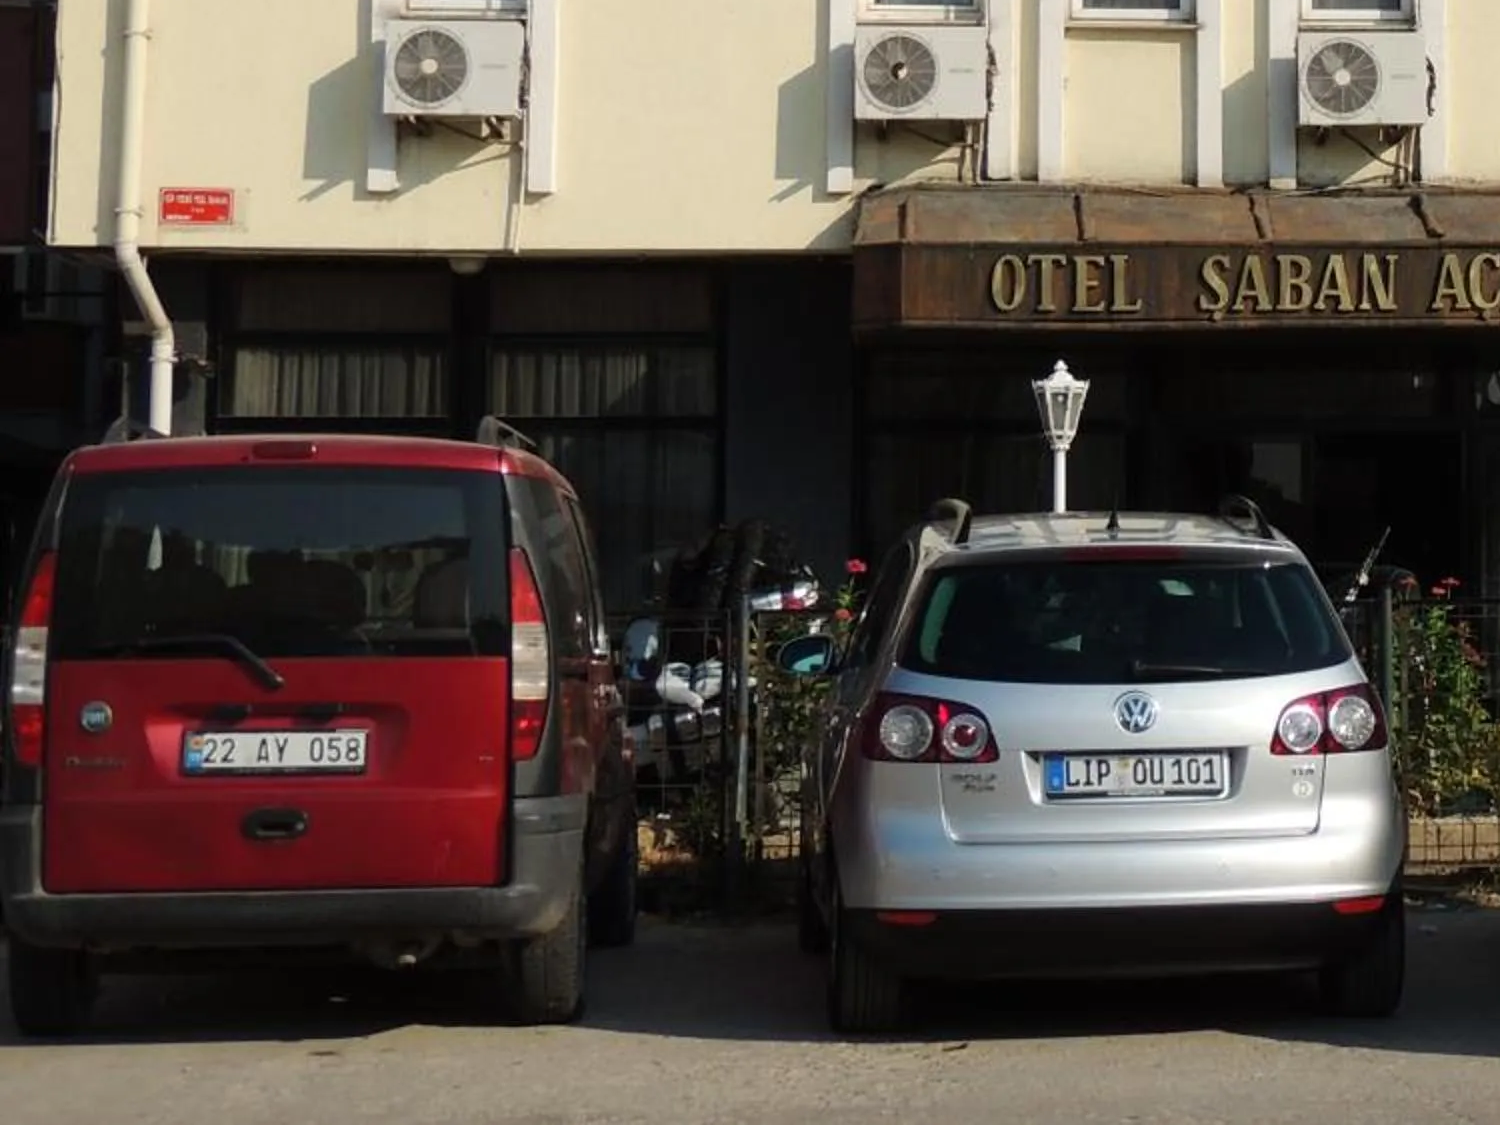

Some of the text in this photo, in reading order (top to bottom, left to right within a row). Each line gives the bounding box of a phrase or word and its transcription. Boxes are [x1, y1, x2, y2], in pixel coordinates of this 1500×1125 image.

[991, 253, 1143, 313] OTEL
[1198, 253, 1399, 323] ŞABAN
[203, 736, 361, 764] 22 AY 058
[1065, 758, 1111, 787] LIP
